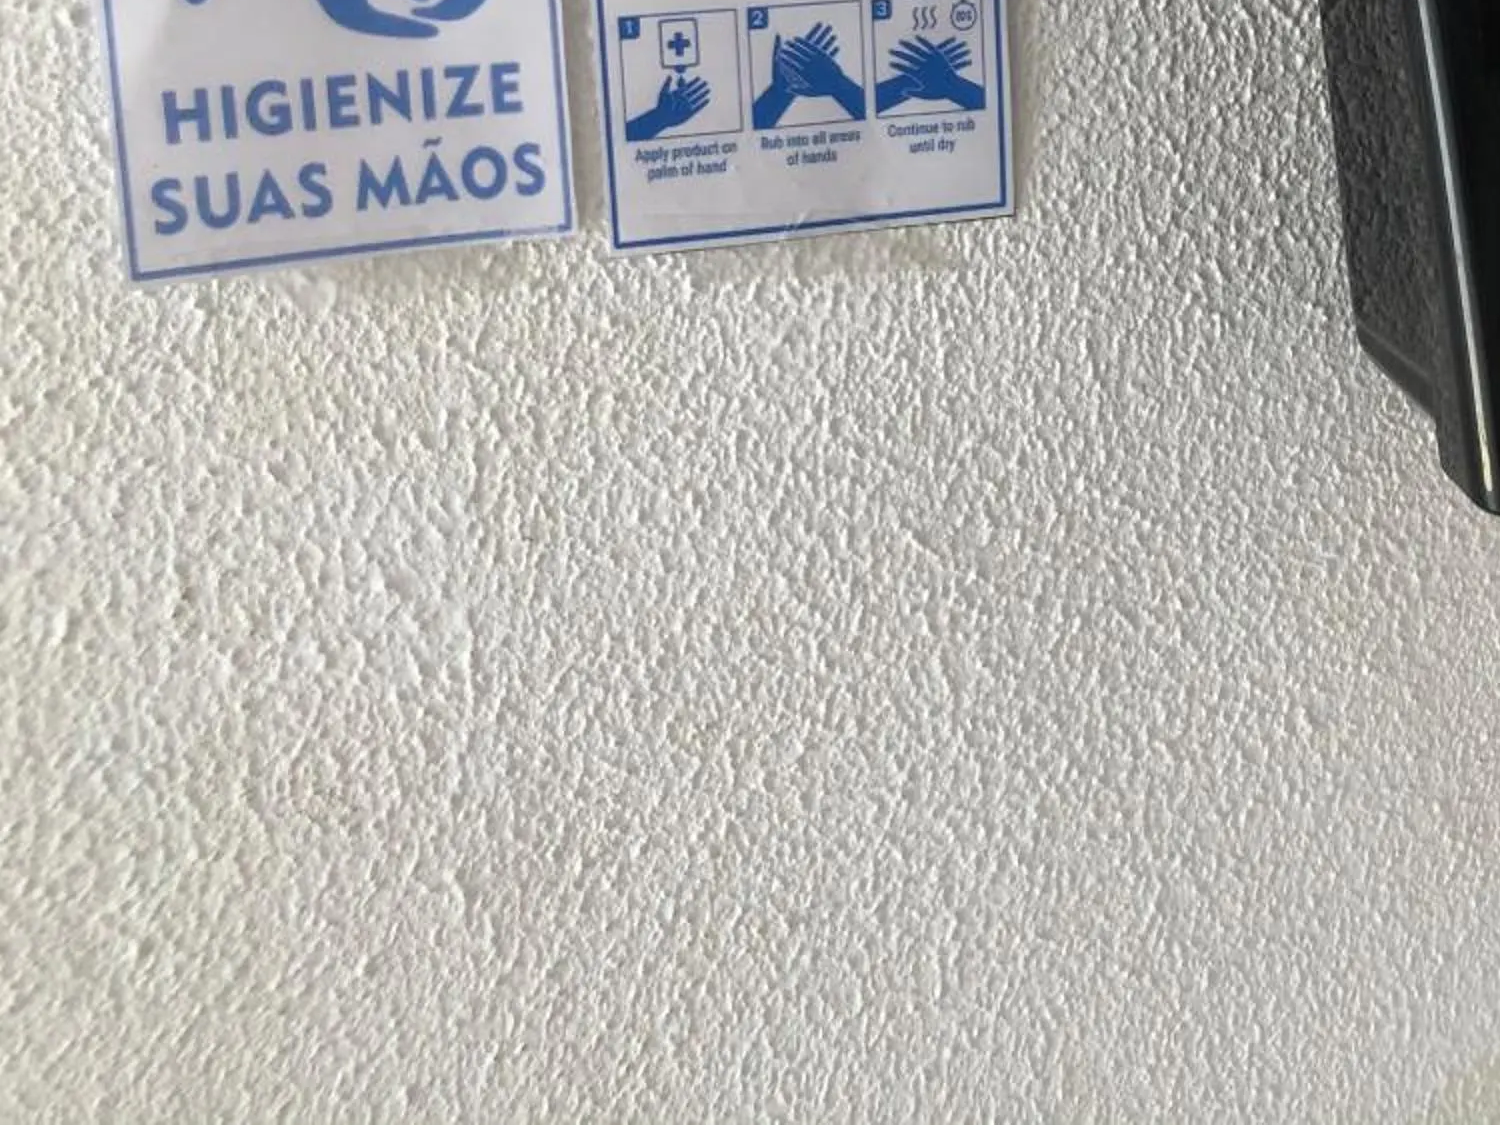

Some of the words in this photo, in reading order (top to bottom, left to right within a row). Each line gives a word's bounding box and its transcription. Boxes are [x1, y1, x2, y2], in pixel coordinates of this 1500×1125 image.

[161, 62, 524, 145] HIGIENIZE
[887, 123, 938, 138] Continue
[943, 120, 954, 135] to
[957, 119, 976, 133] rub
[761, 136, 784, 150] Rub
[787, 132, 809, 147] into
[812, 130, 826, 145] all
[829, 129, 861, 143] areas
[909, 139, 935, 154] until
[938, 137, 957, 154] dry
[671, 141, 719, 161] product
[722, 143, 738, 155] on
[786, 153, 799, 166] of
[802, 148, 838, 164] hands
[681, 161, 693, 176] of
[697, 158, 728, 174] hand
[151, 161, 333, 236] SUAS
[356, 136, 546, 212] MÃOS
